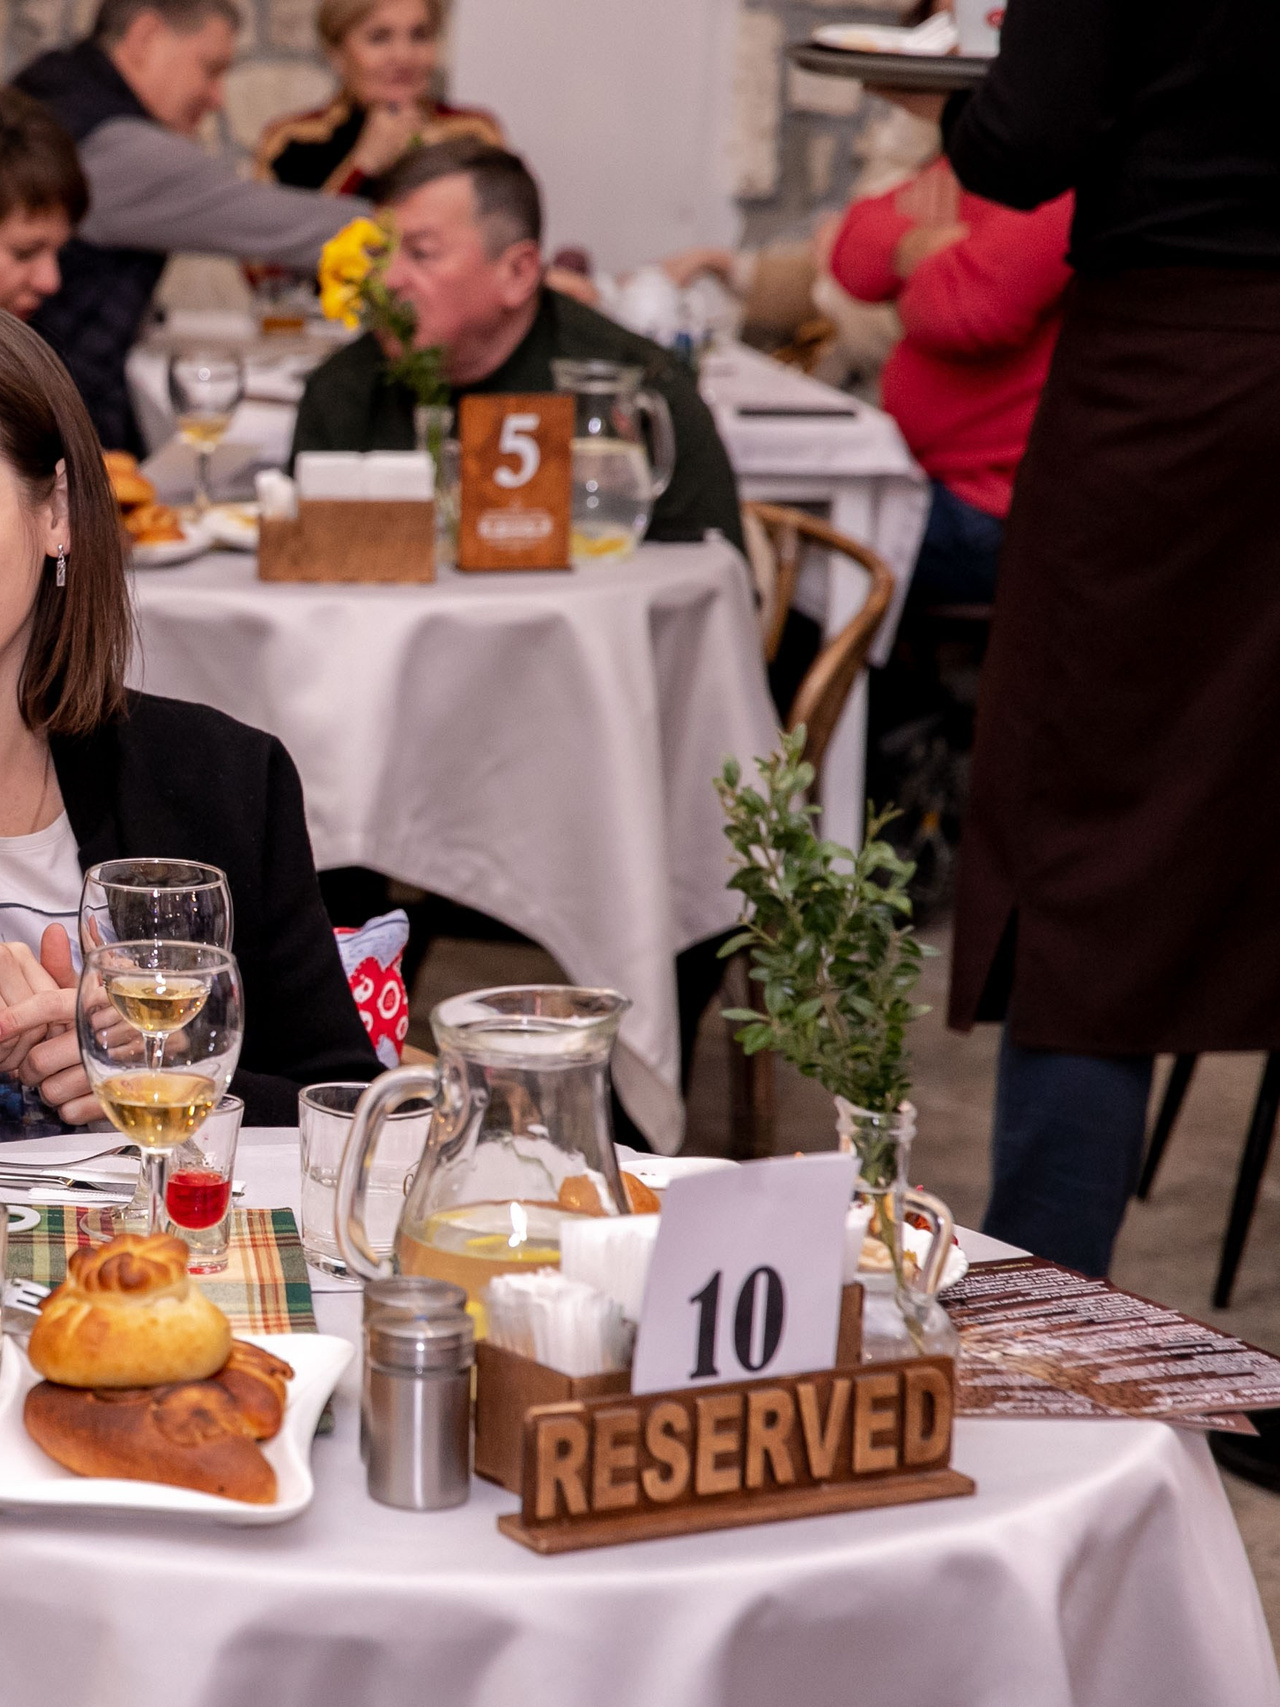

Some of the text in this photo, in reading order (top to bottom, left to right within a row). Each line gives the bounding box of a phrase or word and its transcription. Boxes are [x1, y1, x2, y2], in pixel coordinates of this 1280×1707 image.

[493, 413, 541, 489] 5
[689, 1264, 785, 1379] 10
[535, 1367, 951, 1520] RESERVED
